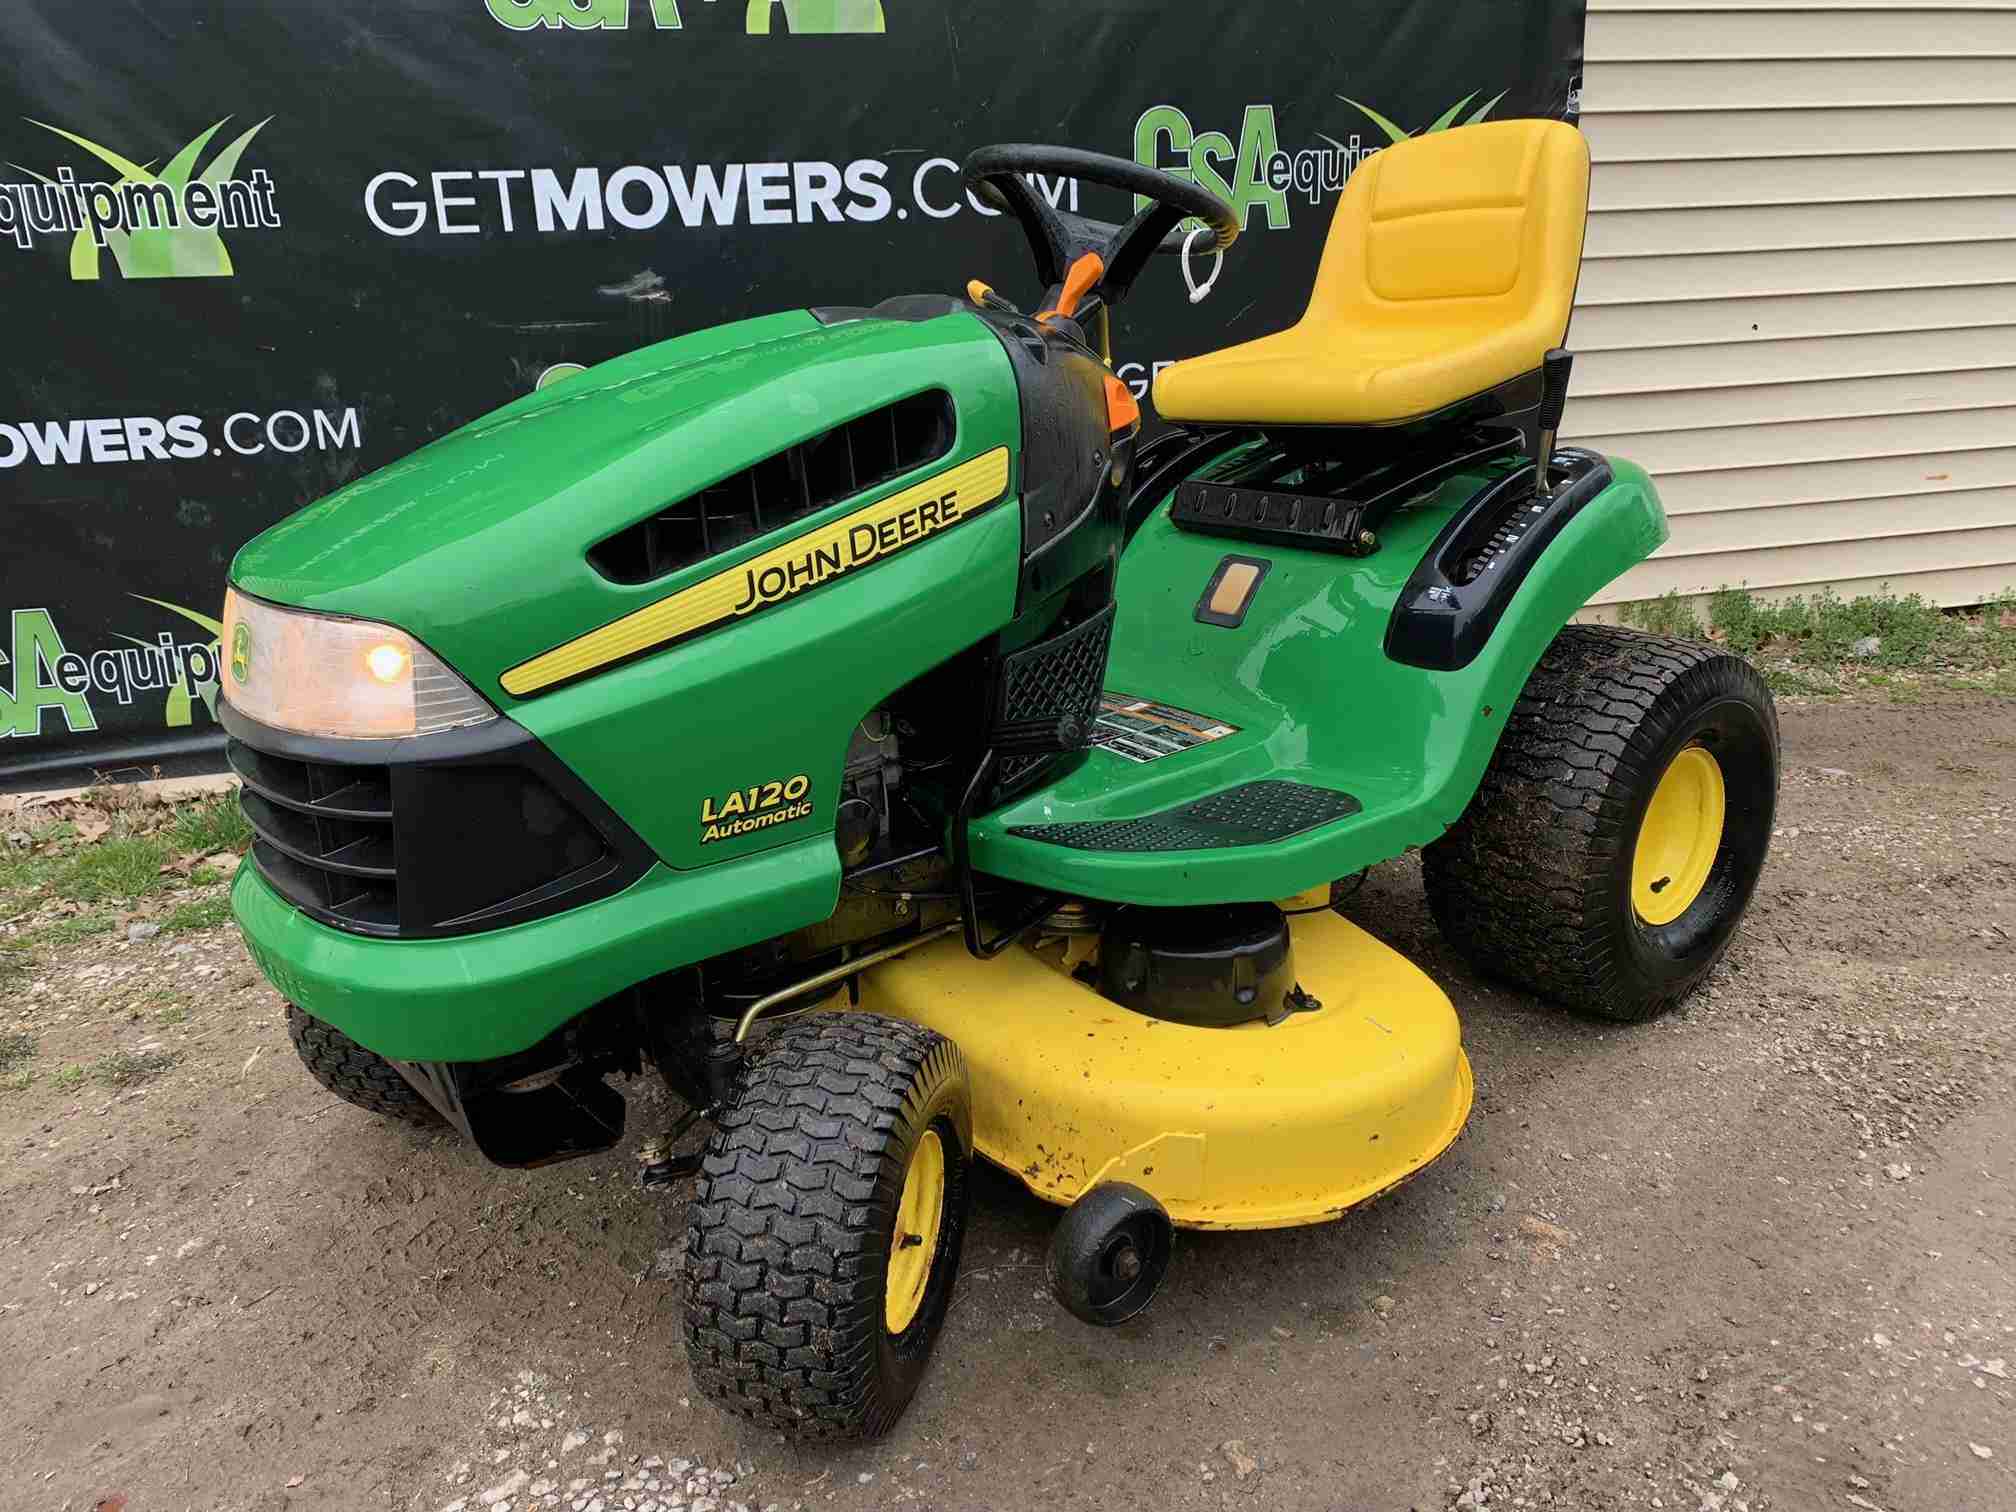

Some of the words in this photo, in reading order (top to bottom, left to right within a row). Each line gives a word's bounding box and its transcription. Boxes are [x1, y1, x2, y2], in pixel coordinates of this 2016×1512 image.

[0, 408, 362, 468] OWERS.COM
[735, 541, 841, 612] JOHN
[848, 490, 960, 562] DEERE
[54, 632, 224, 704] equip
[702, 775, 809, 823] LA120
[702, 802, 812, 842] Automatic
